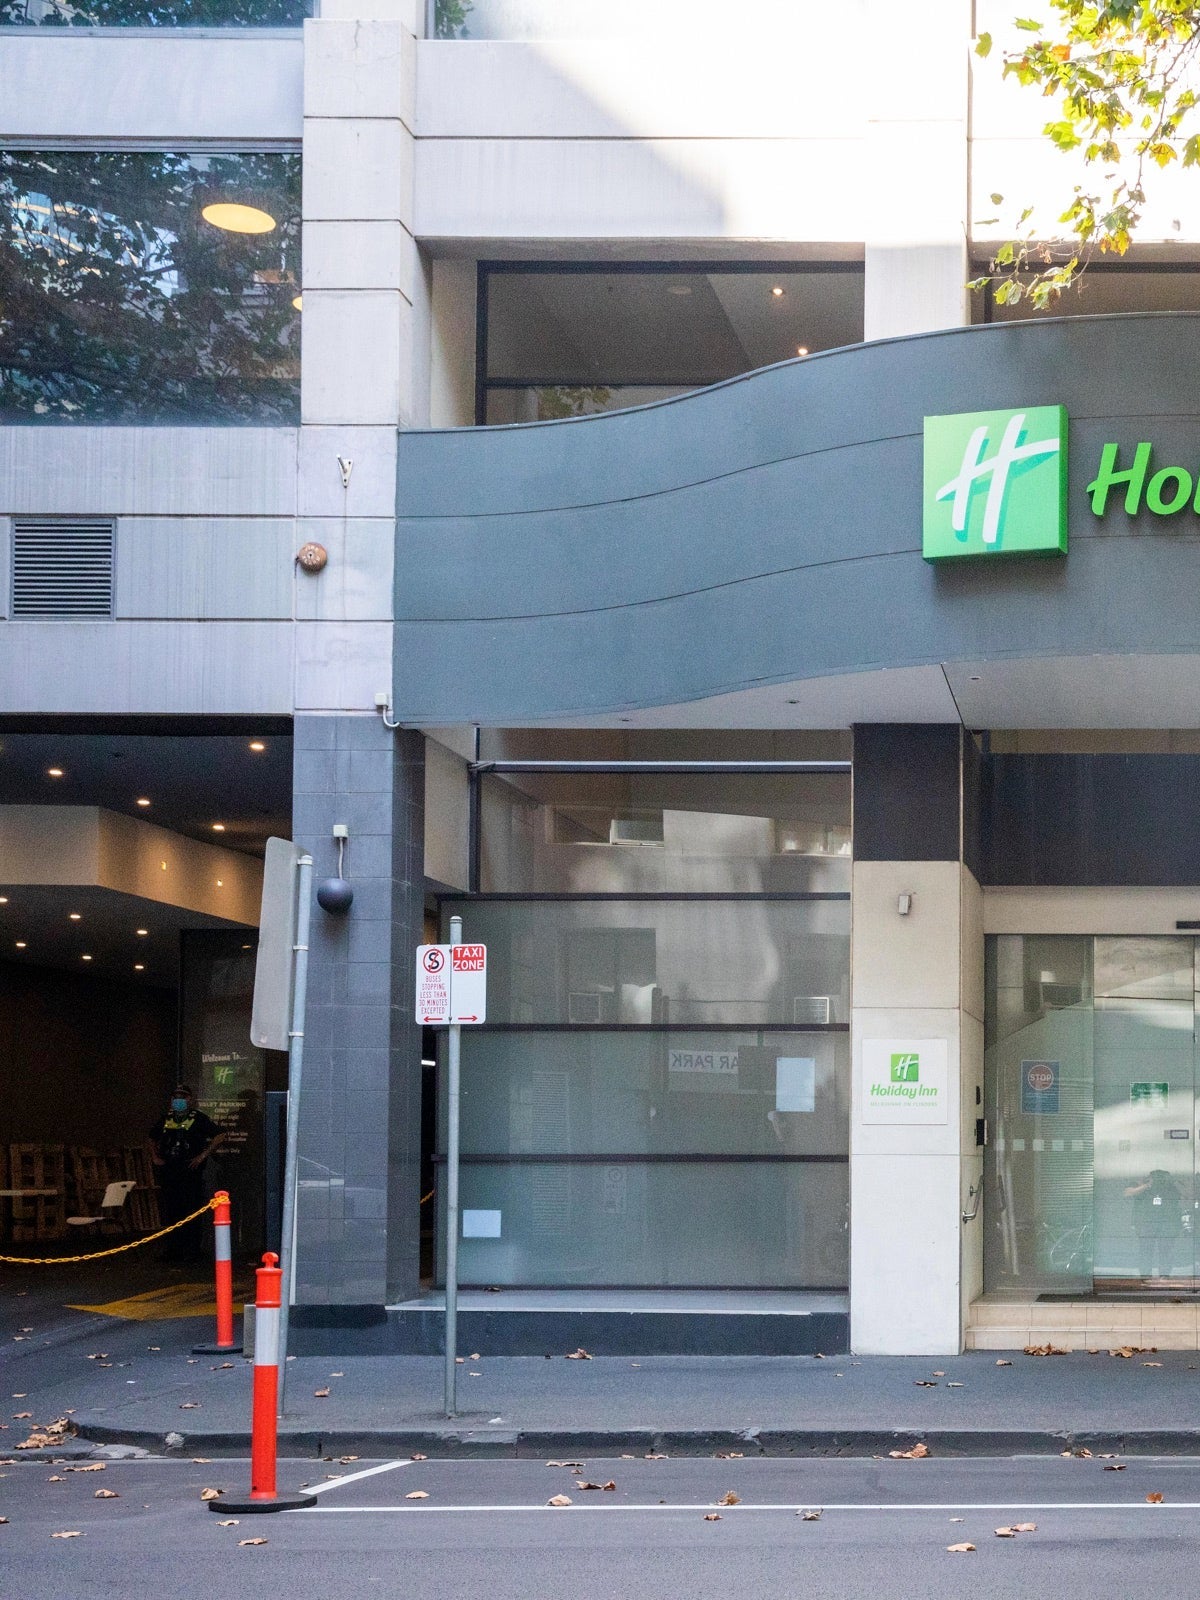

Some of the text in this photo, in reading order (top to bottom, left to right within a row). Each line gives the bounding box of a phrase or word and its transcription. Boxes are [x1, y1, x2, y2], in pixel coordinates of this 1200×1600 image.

[455, 947, 483, 957] TAXI
[453, 960, 484, 970] ZONE
[870, 1084, 938, 1099] Holiday Inn
